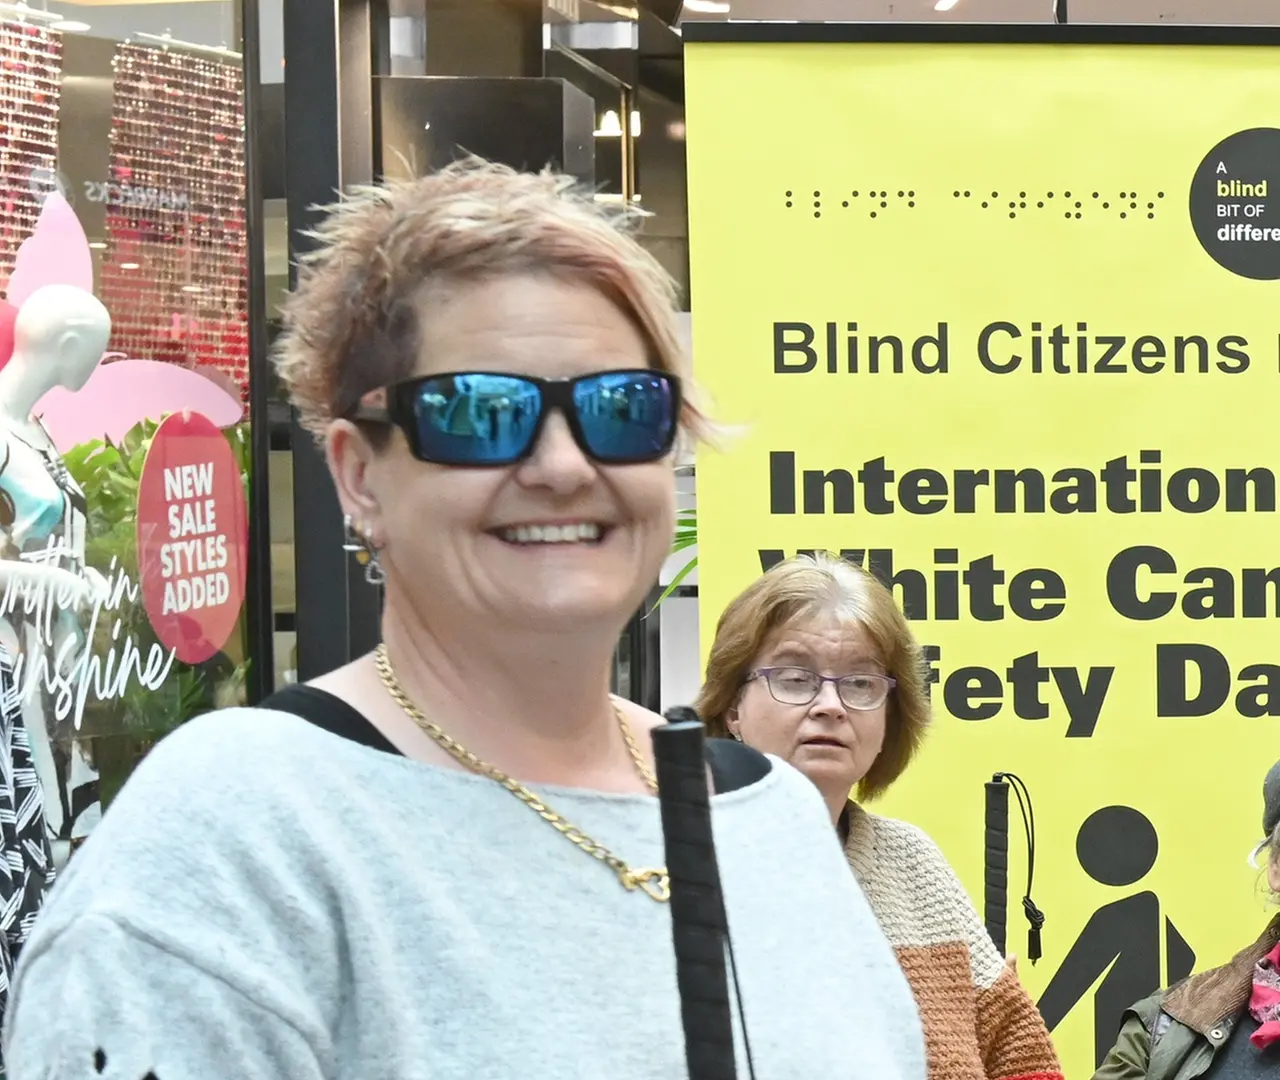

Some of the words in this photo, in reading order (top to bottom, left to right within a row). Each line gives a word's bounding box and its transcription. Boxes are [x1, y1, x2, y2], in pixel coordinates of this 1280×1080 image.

[1216, 161, 1228, 174] A
[1217, 179, 1268, 197] blind
[1216, 204, 1241, 218] BIT
[1244, 204, 1266, 218] OF
[774, 322, 950, 376] Blind
[977, 322, 1252, 376] Citizens
[163, 462, 214, 501] NEW
[167, 499, 217, 539] SALE
[160, 534, 229, 578] STYLES
[162, 571, 230, 616] ADDED
[758, 546, 1068, 623] hite
[921, 645, 1115, 738] fety
